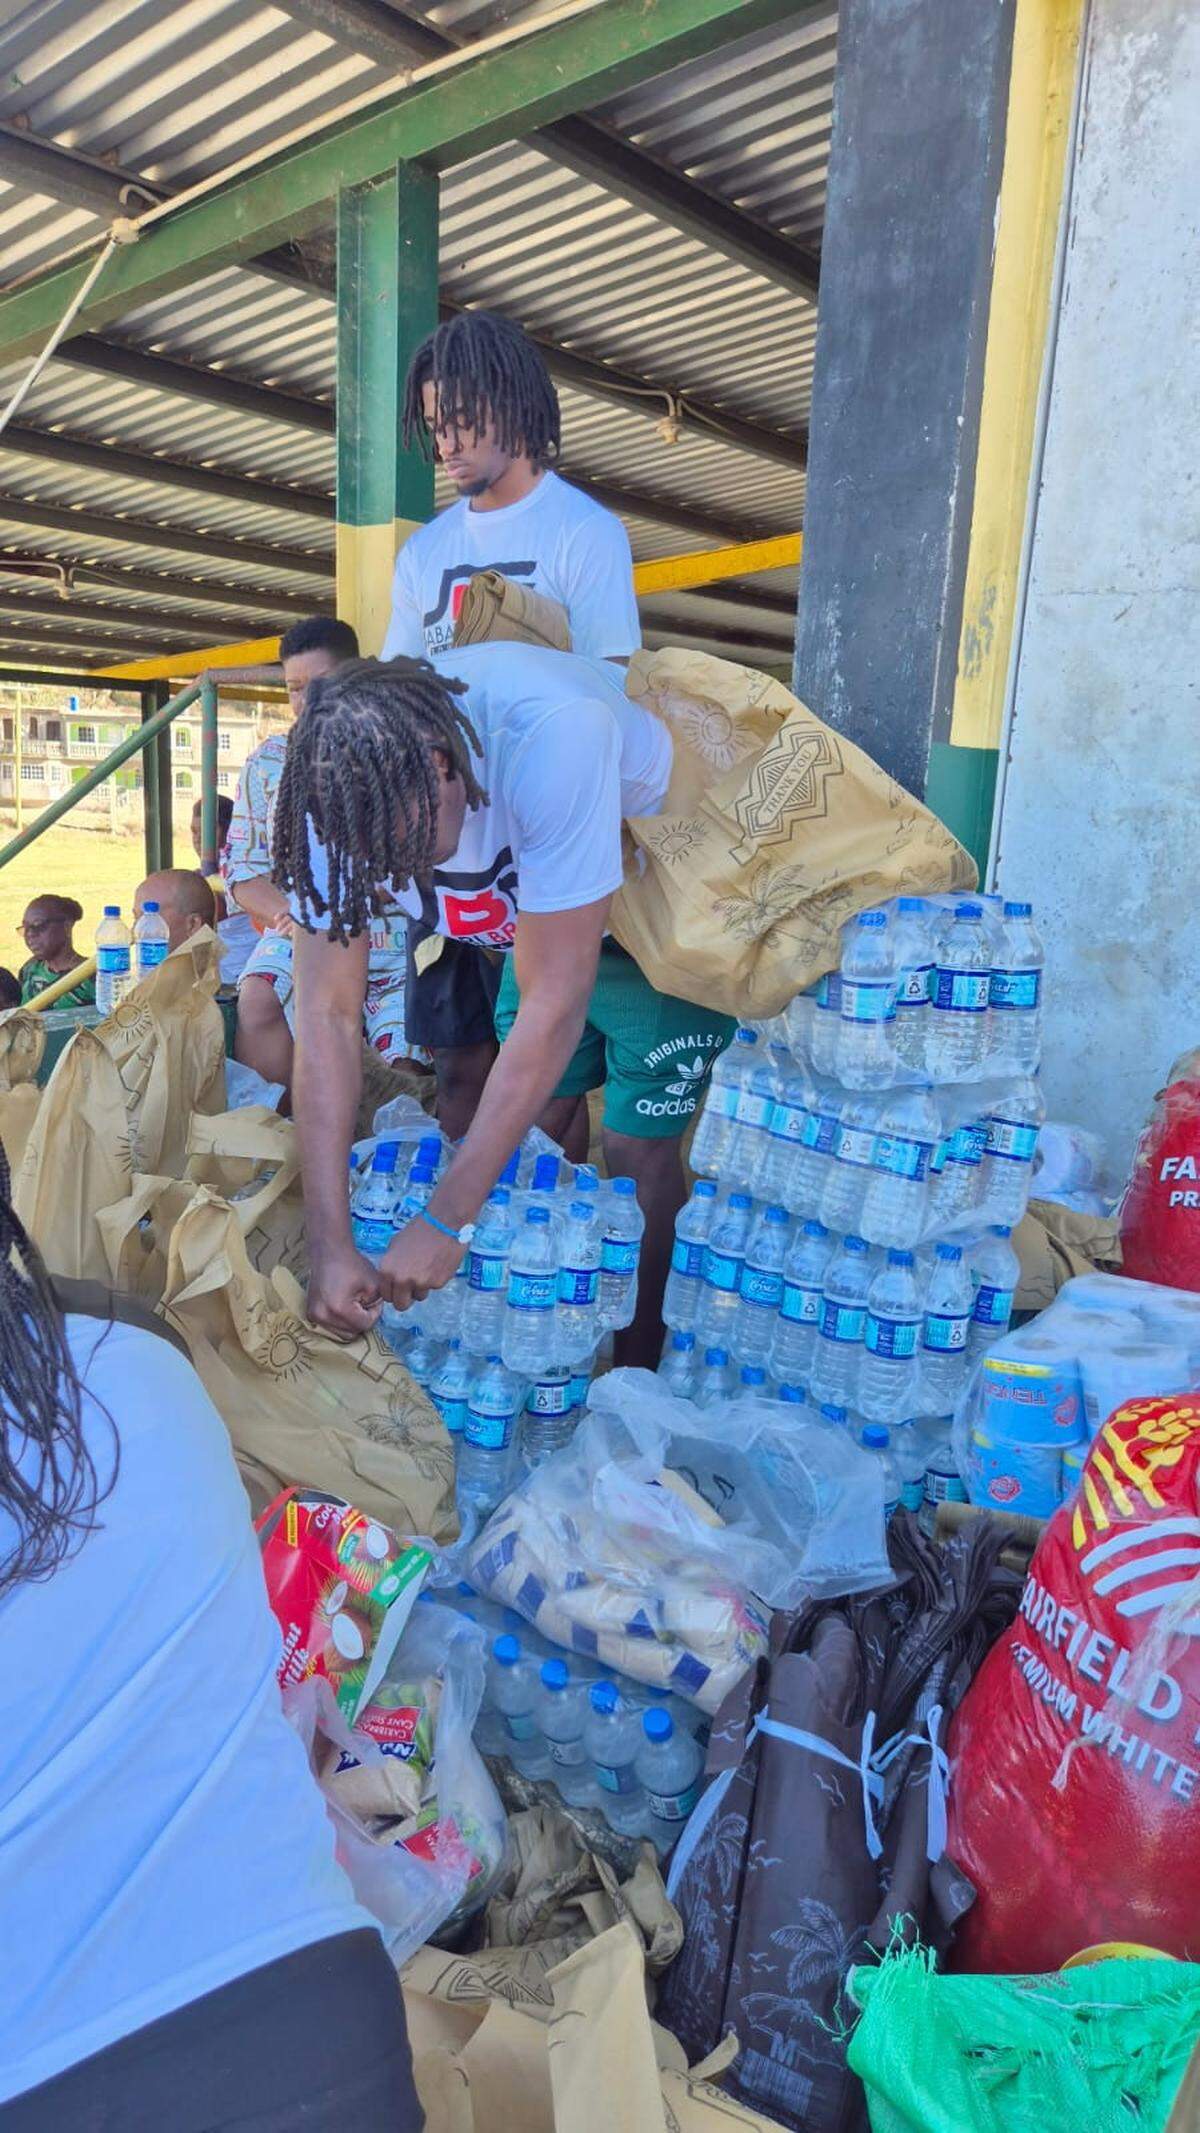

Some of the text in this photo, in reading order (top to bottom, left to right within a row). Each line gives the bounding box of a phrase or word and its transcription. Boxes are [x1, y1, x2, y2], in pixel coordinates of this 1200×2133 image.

[762, 748, 813, 813] THANK YOU
[636, 1099, 696, 1117] addas
[1160, 1155, 1200, 1183] FA
[1169, 1190, 1200, 1209] PR
[1019, 1572, 1182, 1722] AIRFIELD
[1081, 1704, 1199, 1802] WHITE
